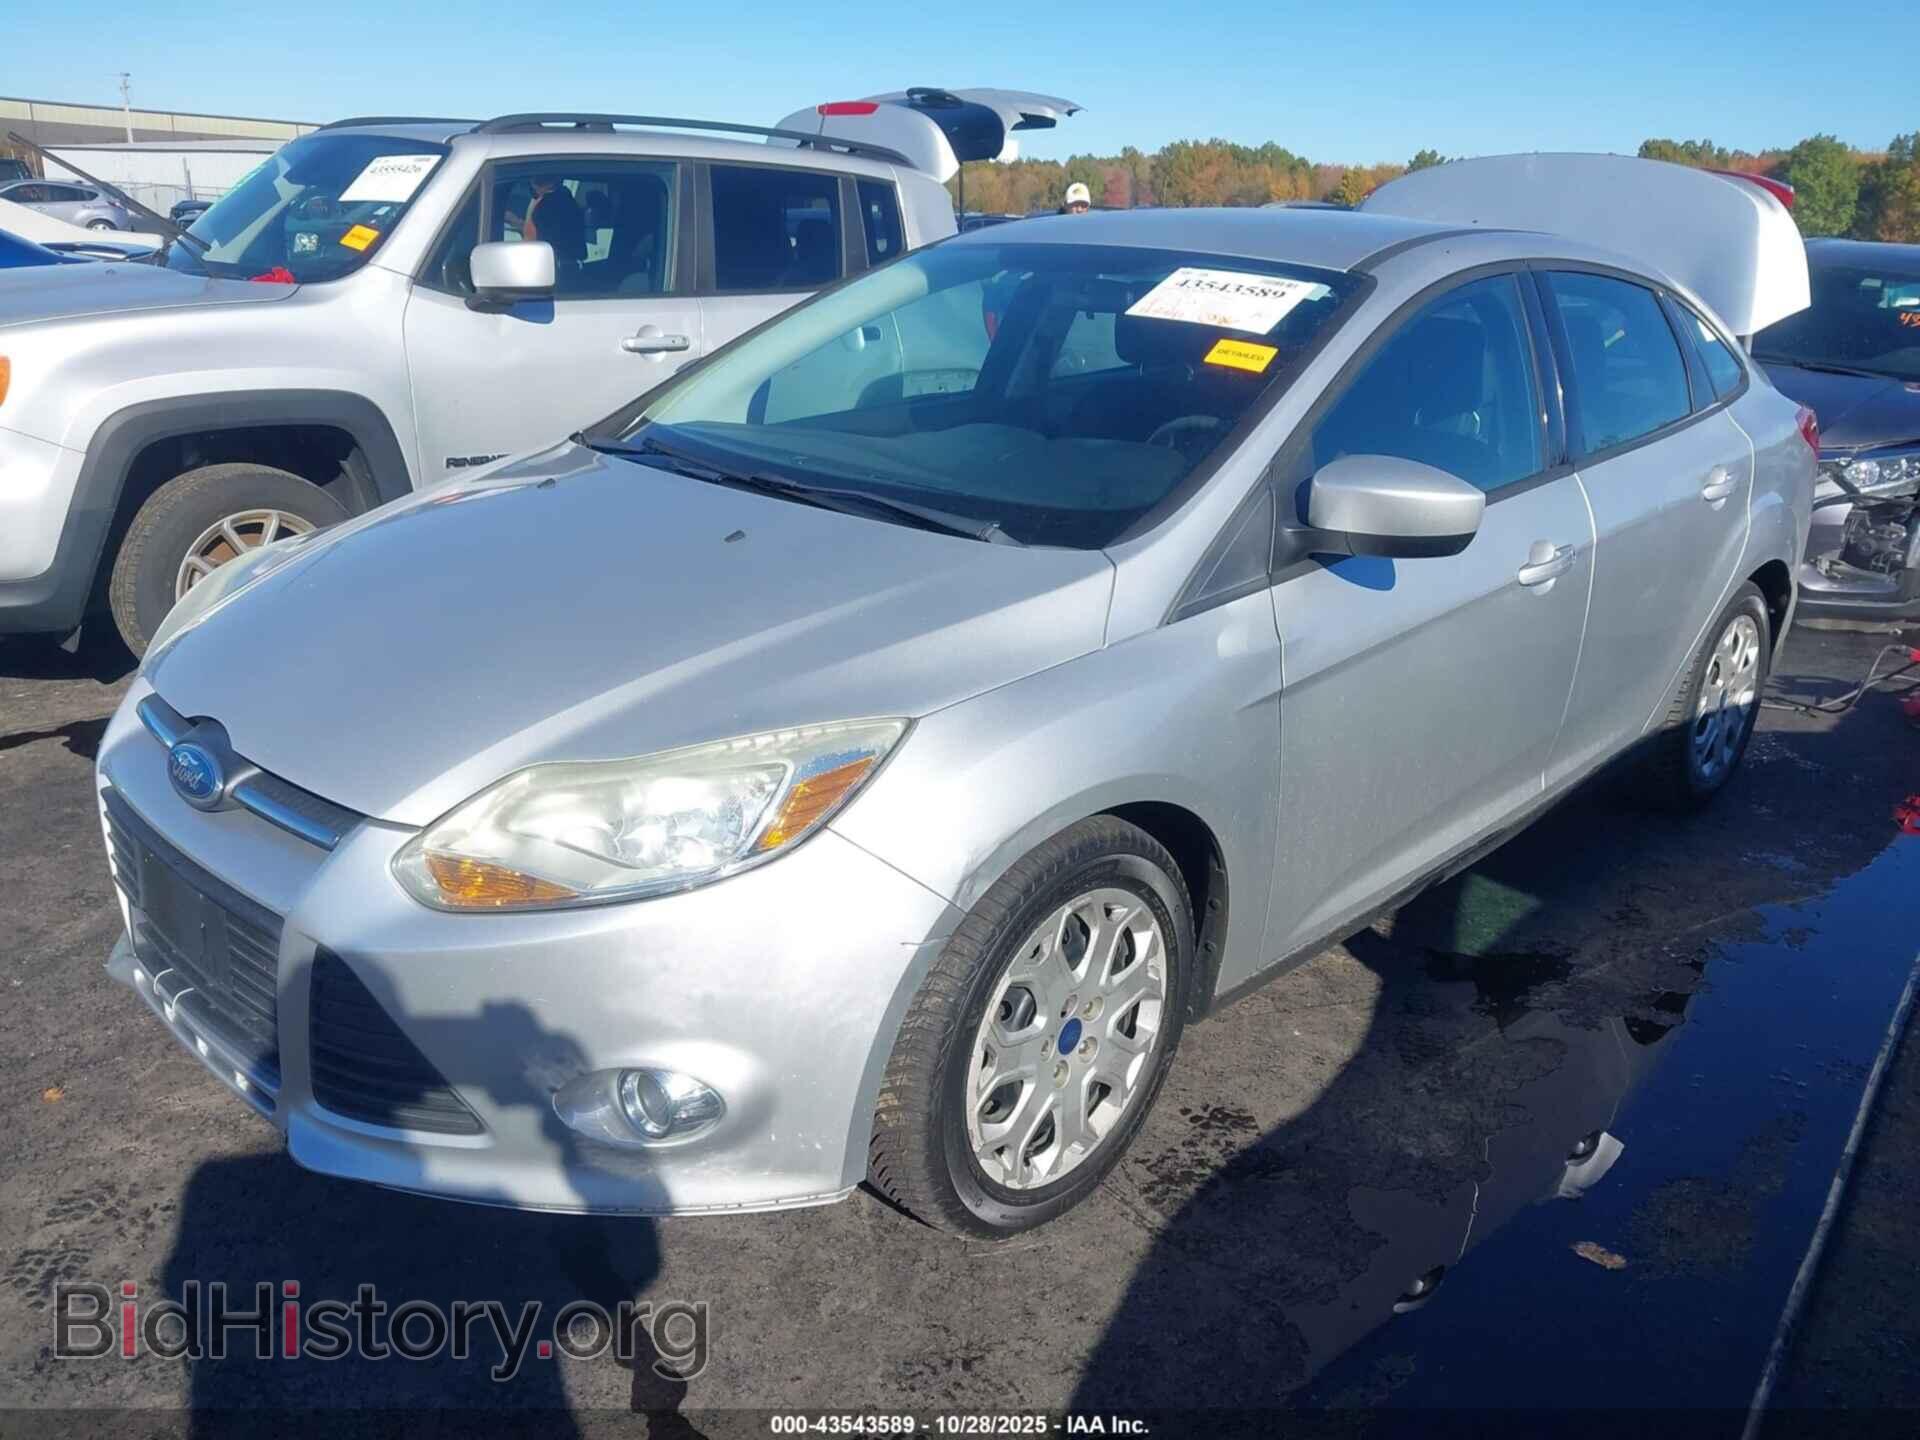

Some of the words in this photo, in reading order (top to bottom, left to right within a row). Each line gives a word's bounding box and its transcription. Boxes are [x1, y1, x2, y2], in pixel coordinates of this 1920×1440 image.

[1176, 279, 1287, 299] 43543589
[1216, 348, 1266, 361] DETAILED
[446, 453, 511, 468] RENEGA
[172, 751, 204, 790] Ford
